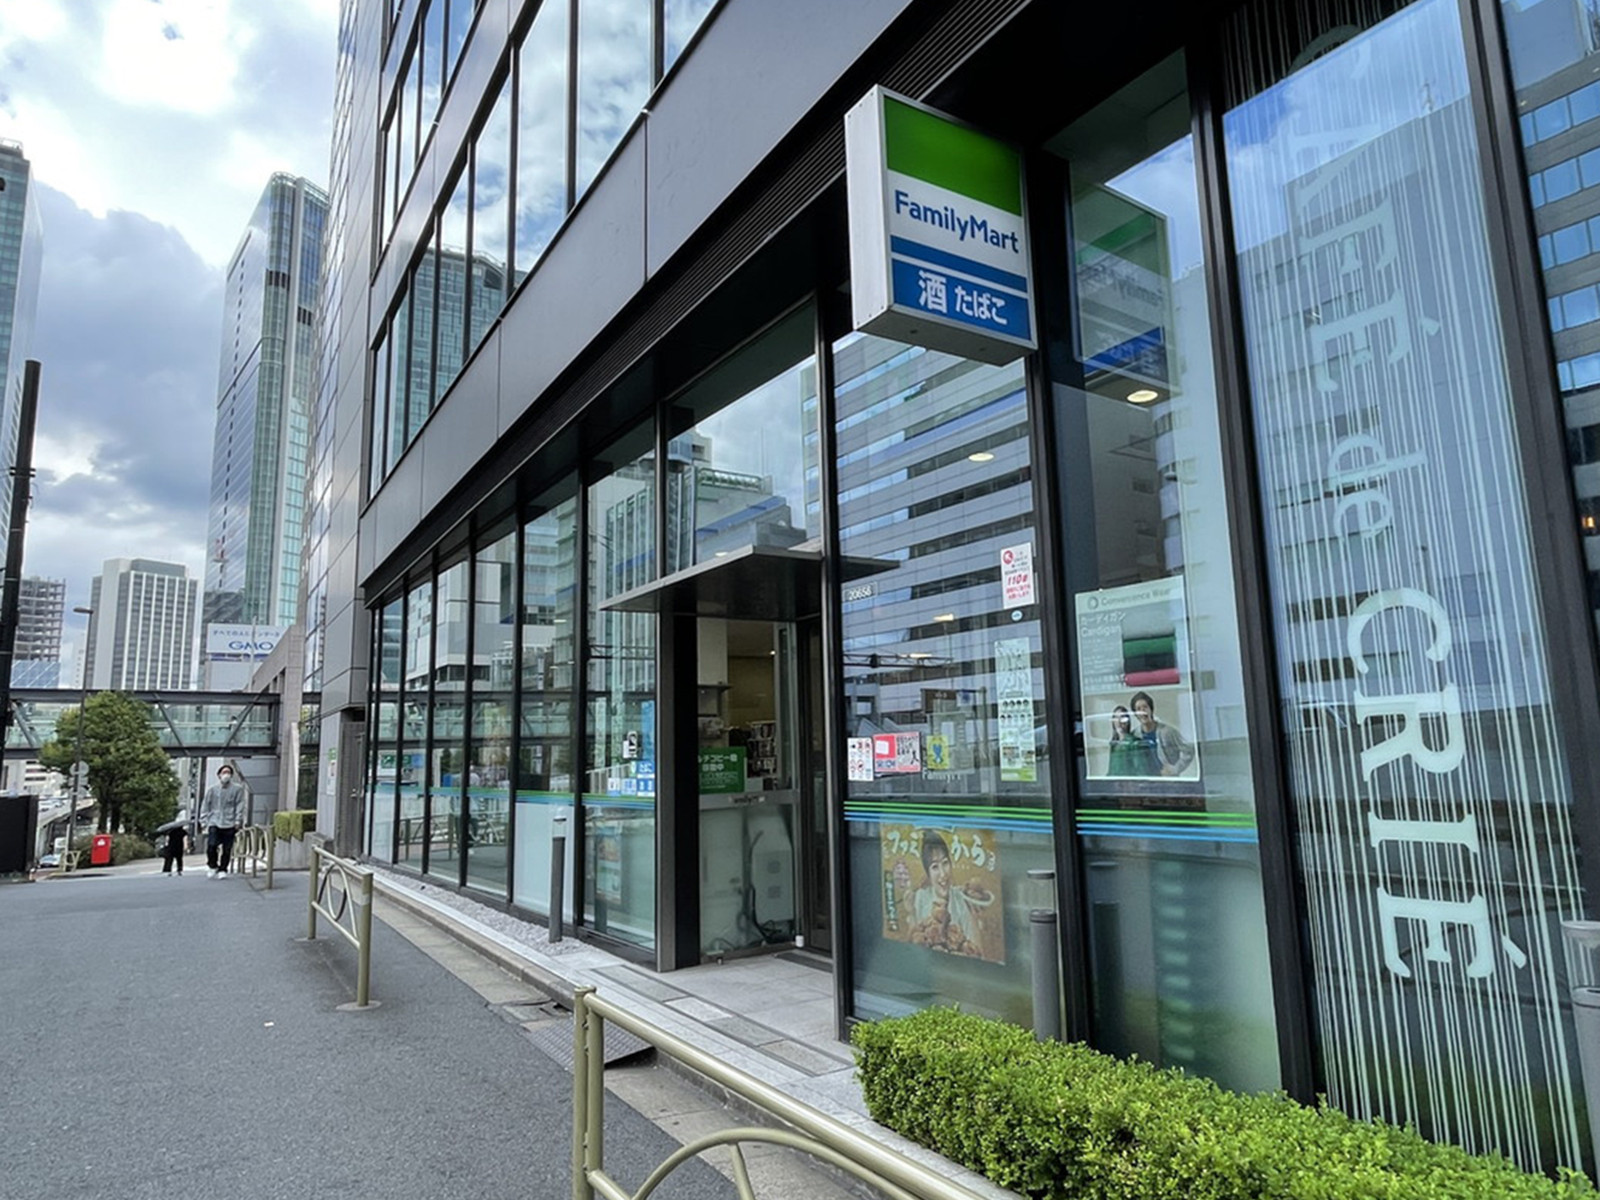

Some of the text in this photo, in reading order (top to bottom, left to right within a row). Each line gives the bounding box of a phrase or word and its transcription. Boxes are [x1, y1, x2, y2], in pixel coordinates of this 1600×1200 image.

[895, 189, 1019, 254] FamilyMart
[918, 269, 1008, 325] 酒 たばこ
[1327, 433, 1427, 543] de
[229, 640, 274, 651] GMO
[1347, 587, 1527, 979] CRIÉ
